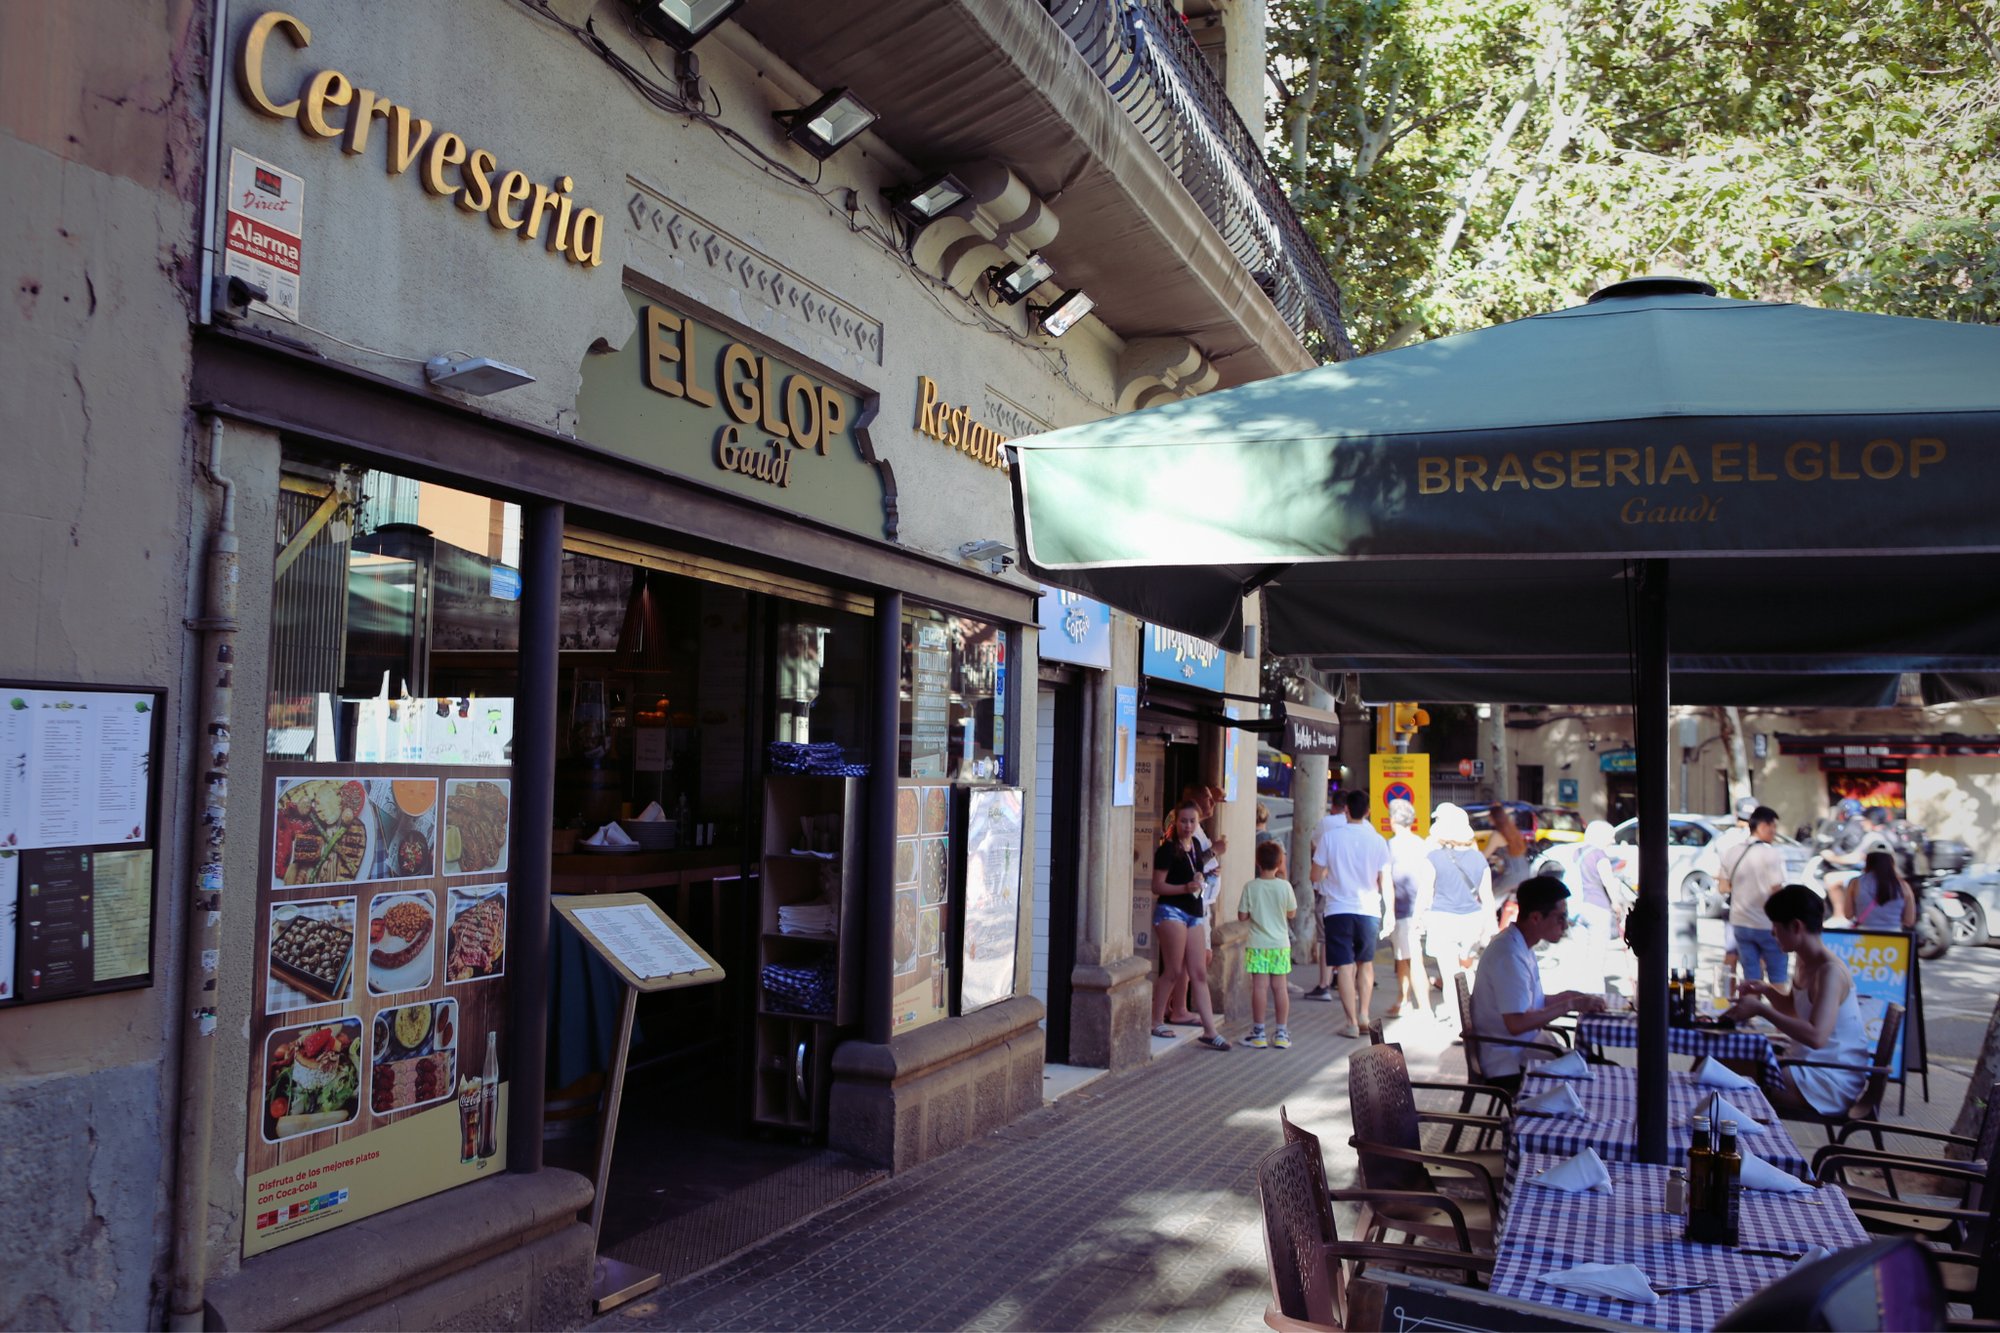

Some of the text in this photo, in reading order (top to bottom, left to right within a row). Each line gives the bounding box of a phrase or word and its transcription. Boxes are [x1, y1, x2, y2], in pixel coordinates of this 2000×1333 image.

[237, 10, 604, 268] Cerveseria
[242, 190, 292, 212] Direct
[229, 239, 244, 249] con
[246, 243, 267, 258] Aviso
[268, 253, 273, 261] a
[231, 220, 299, 260] Alarma
[646, 304, 846, 456] EL GLOP
[1417, 437, 1948, 495] BRASERIA EL GLOP
[1620, 495, 1725, 526] Gaudí
[258, 1150, 380, 1192] Disfruta de los mejores platos
[257, 1180, 318, 1205] con Coca-Cola
